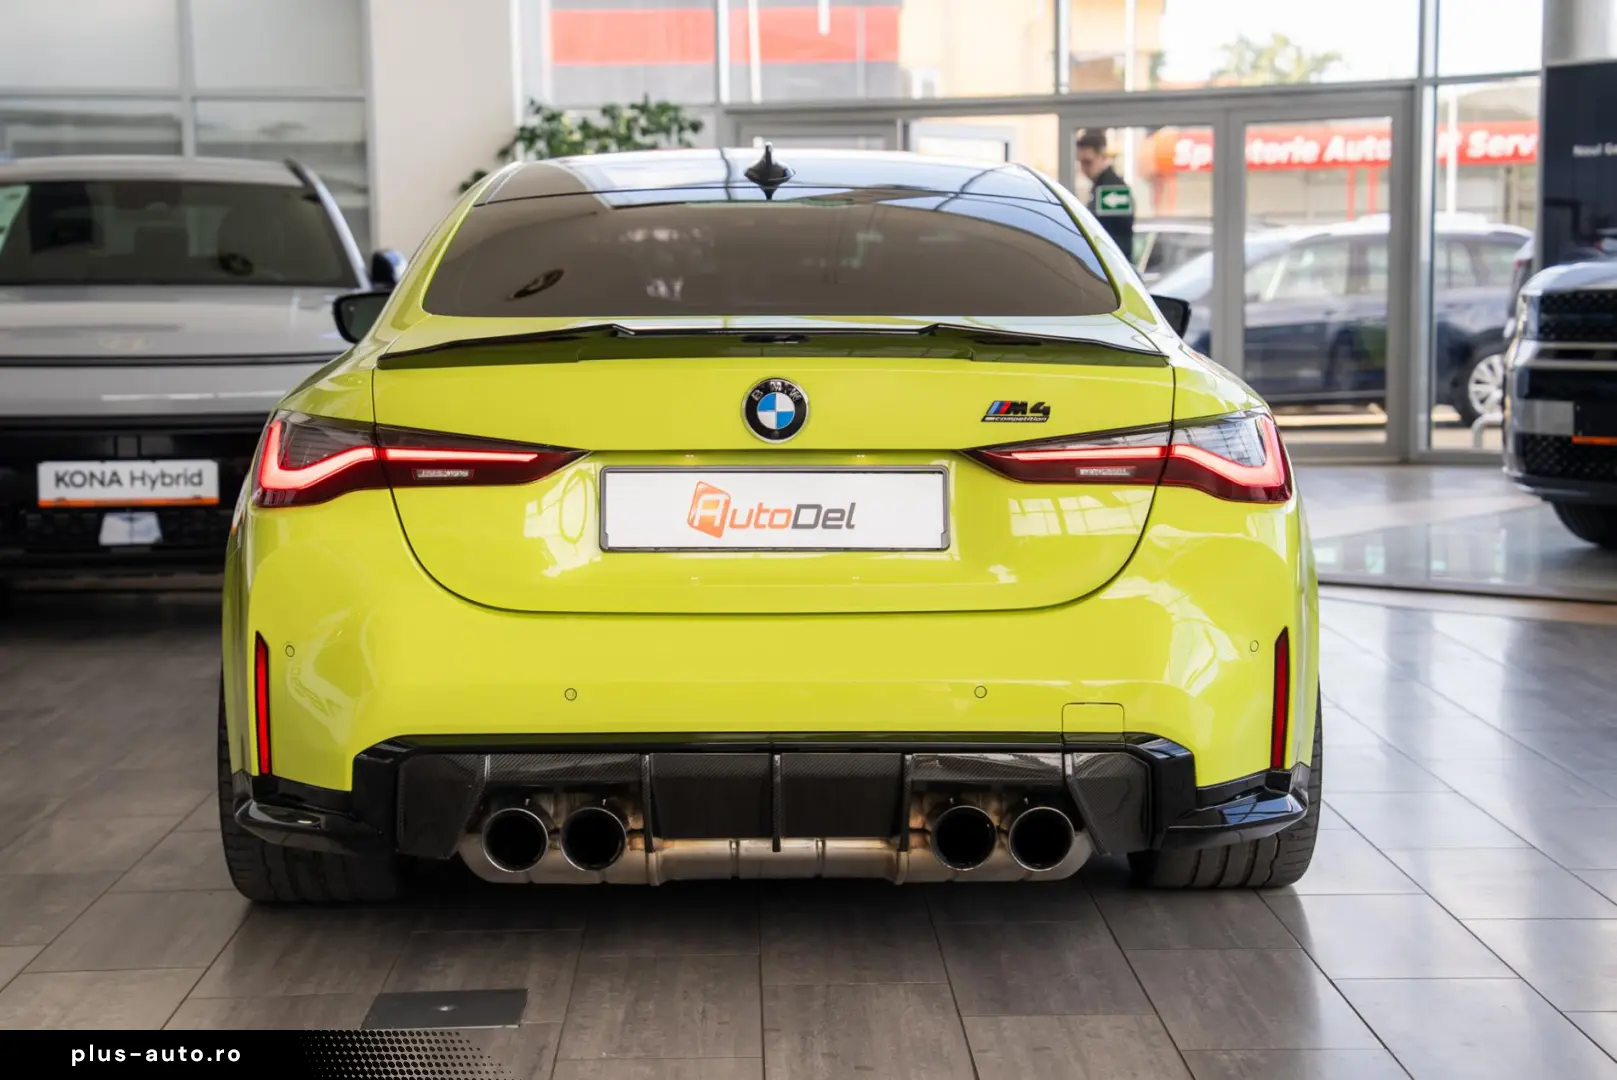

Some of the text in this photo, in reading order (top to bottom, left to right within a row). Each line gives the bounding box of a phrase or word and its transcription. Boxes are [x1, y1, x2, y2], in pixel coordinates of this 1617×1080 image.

[1466, 130, 1538, 158] Serv
[751, 380, 802, 402] BMW
[1004, 400, 1051, 416] M4
[54, 468, 204, 491] KONA Hybrid
[689, 490, 857, 532] AutoDel
